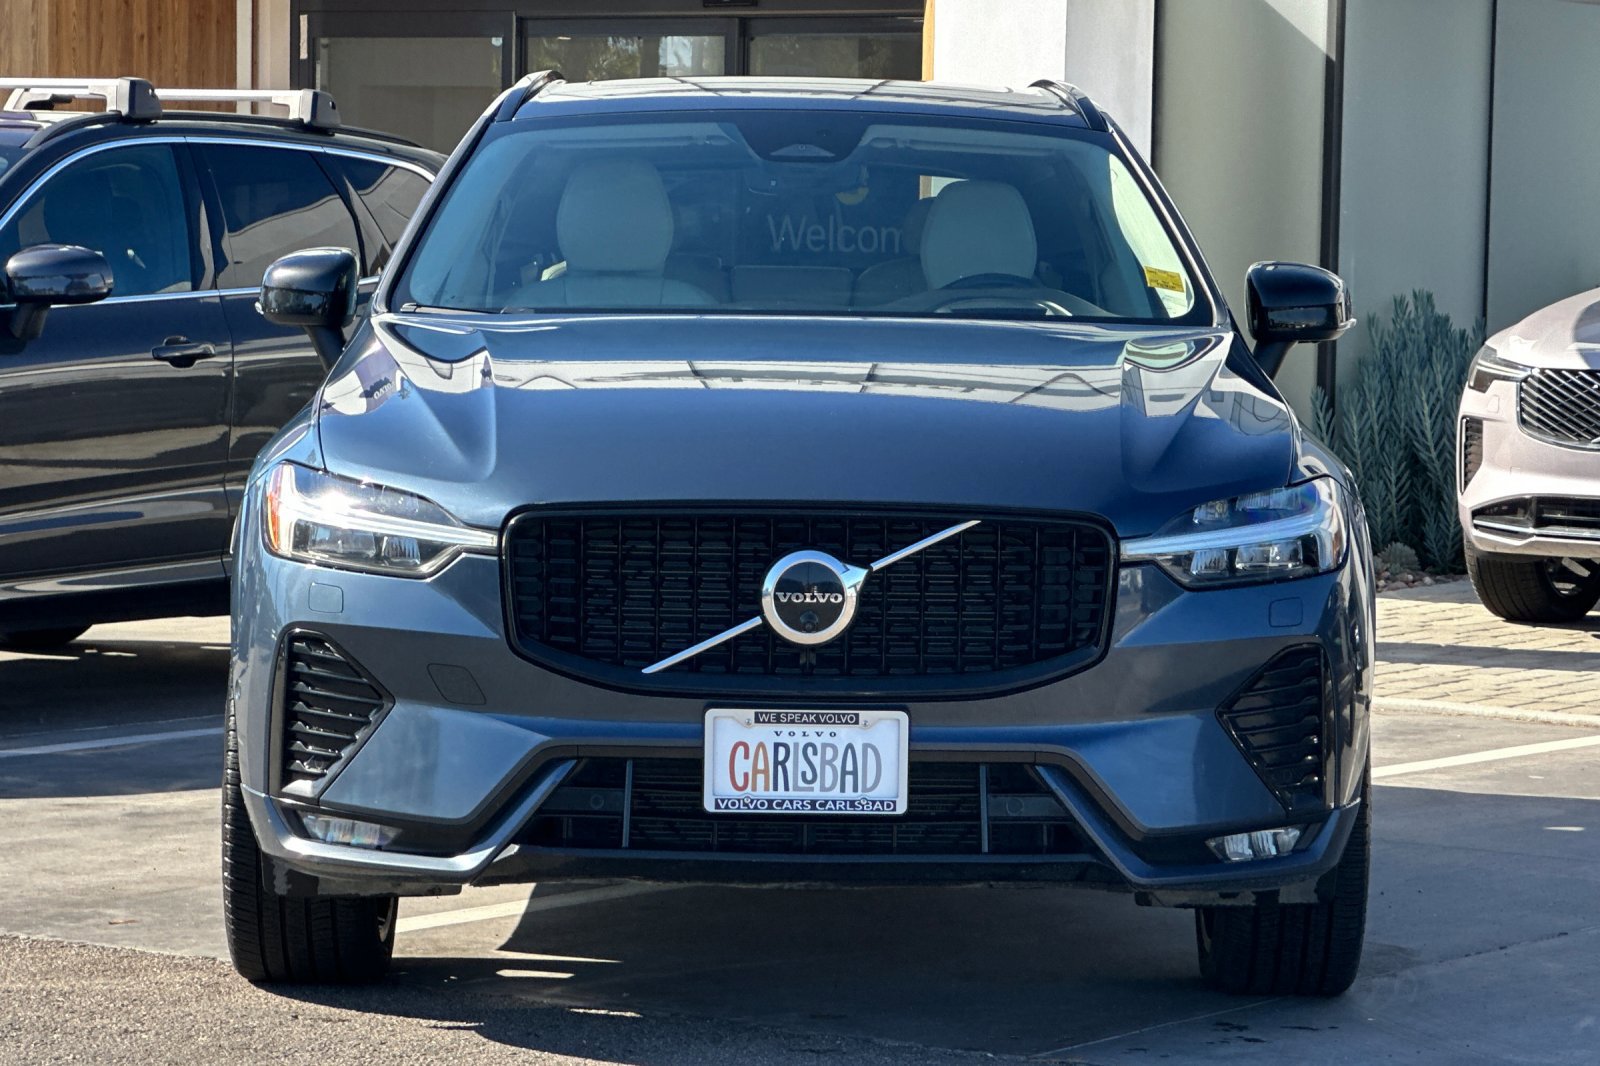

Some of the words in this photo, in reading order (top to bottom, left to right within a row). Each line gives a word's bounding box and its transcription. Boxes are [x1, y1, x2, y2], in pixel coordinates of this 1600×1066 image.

[775, 592, 843, 603] VOLVO
[758, 713, 777, 723] WE
[780, 713, 817, 723] SPEAK
[819, 714, 856, 724] VOLVO
[729, 741, 882, 793] CARLSBAD
[717, 799, 768, 809] VOLVO
[772, 800, 811, 810] CARS
[815, 800, 894, 811] CARLSBAD
